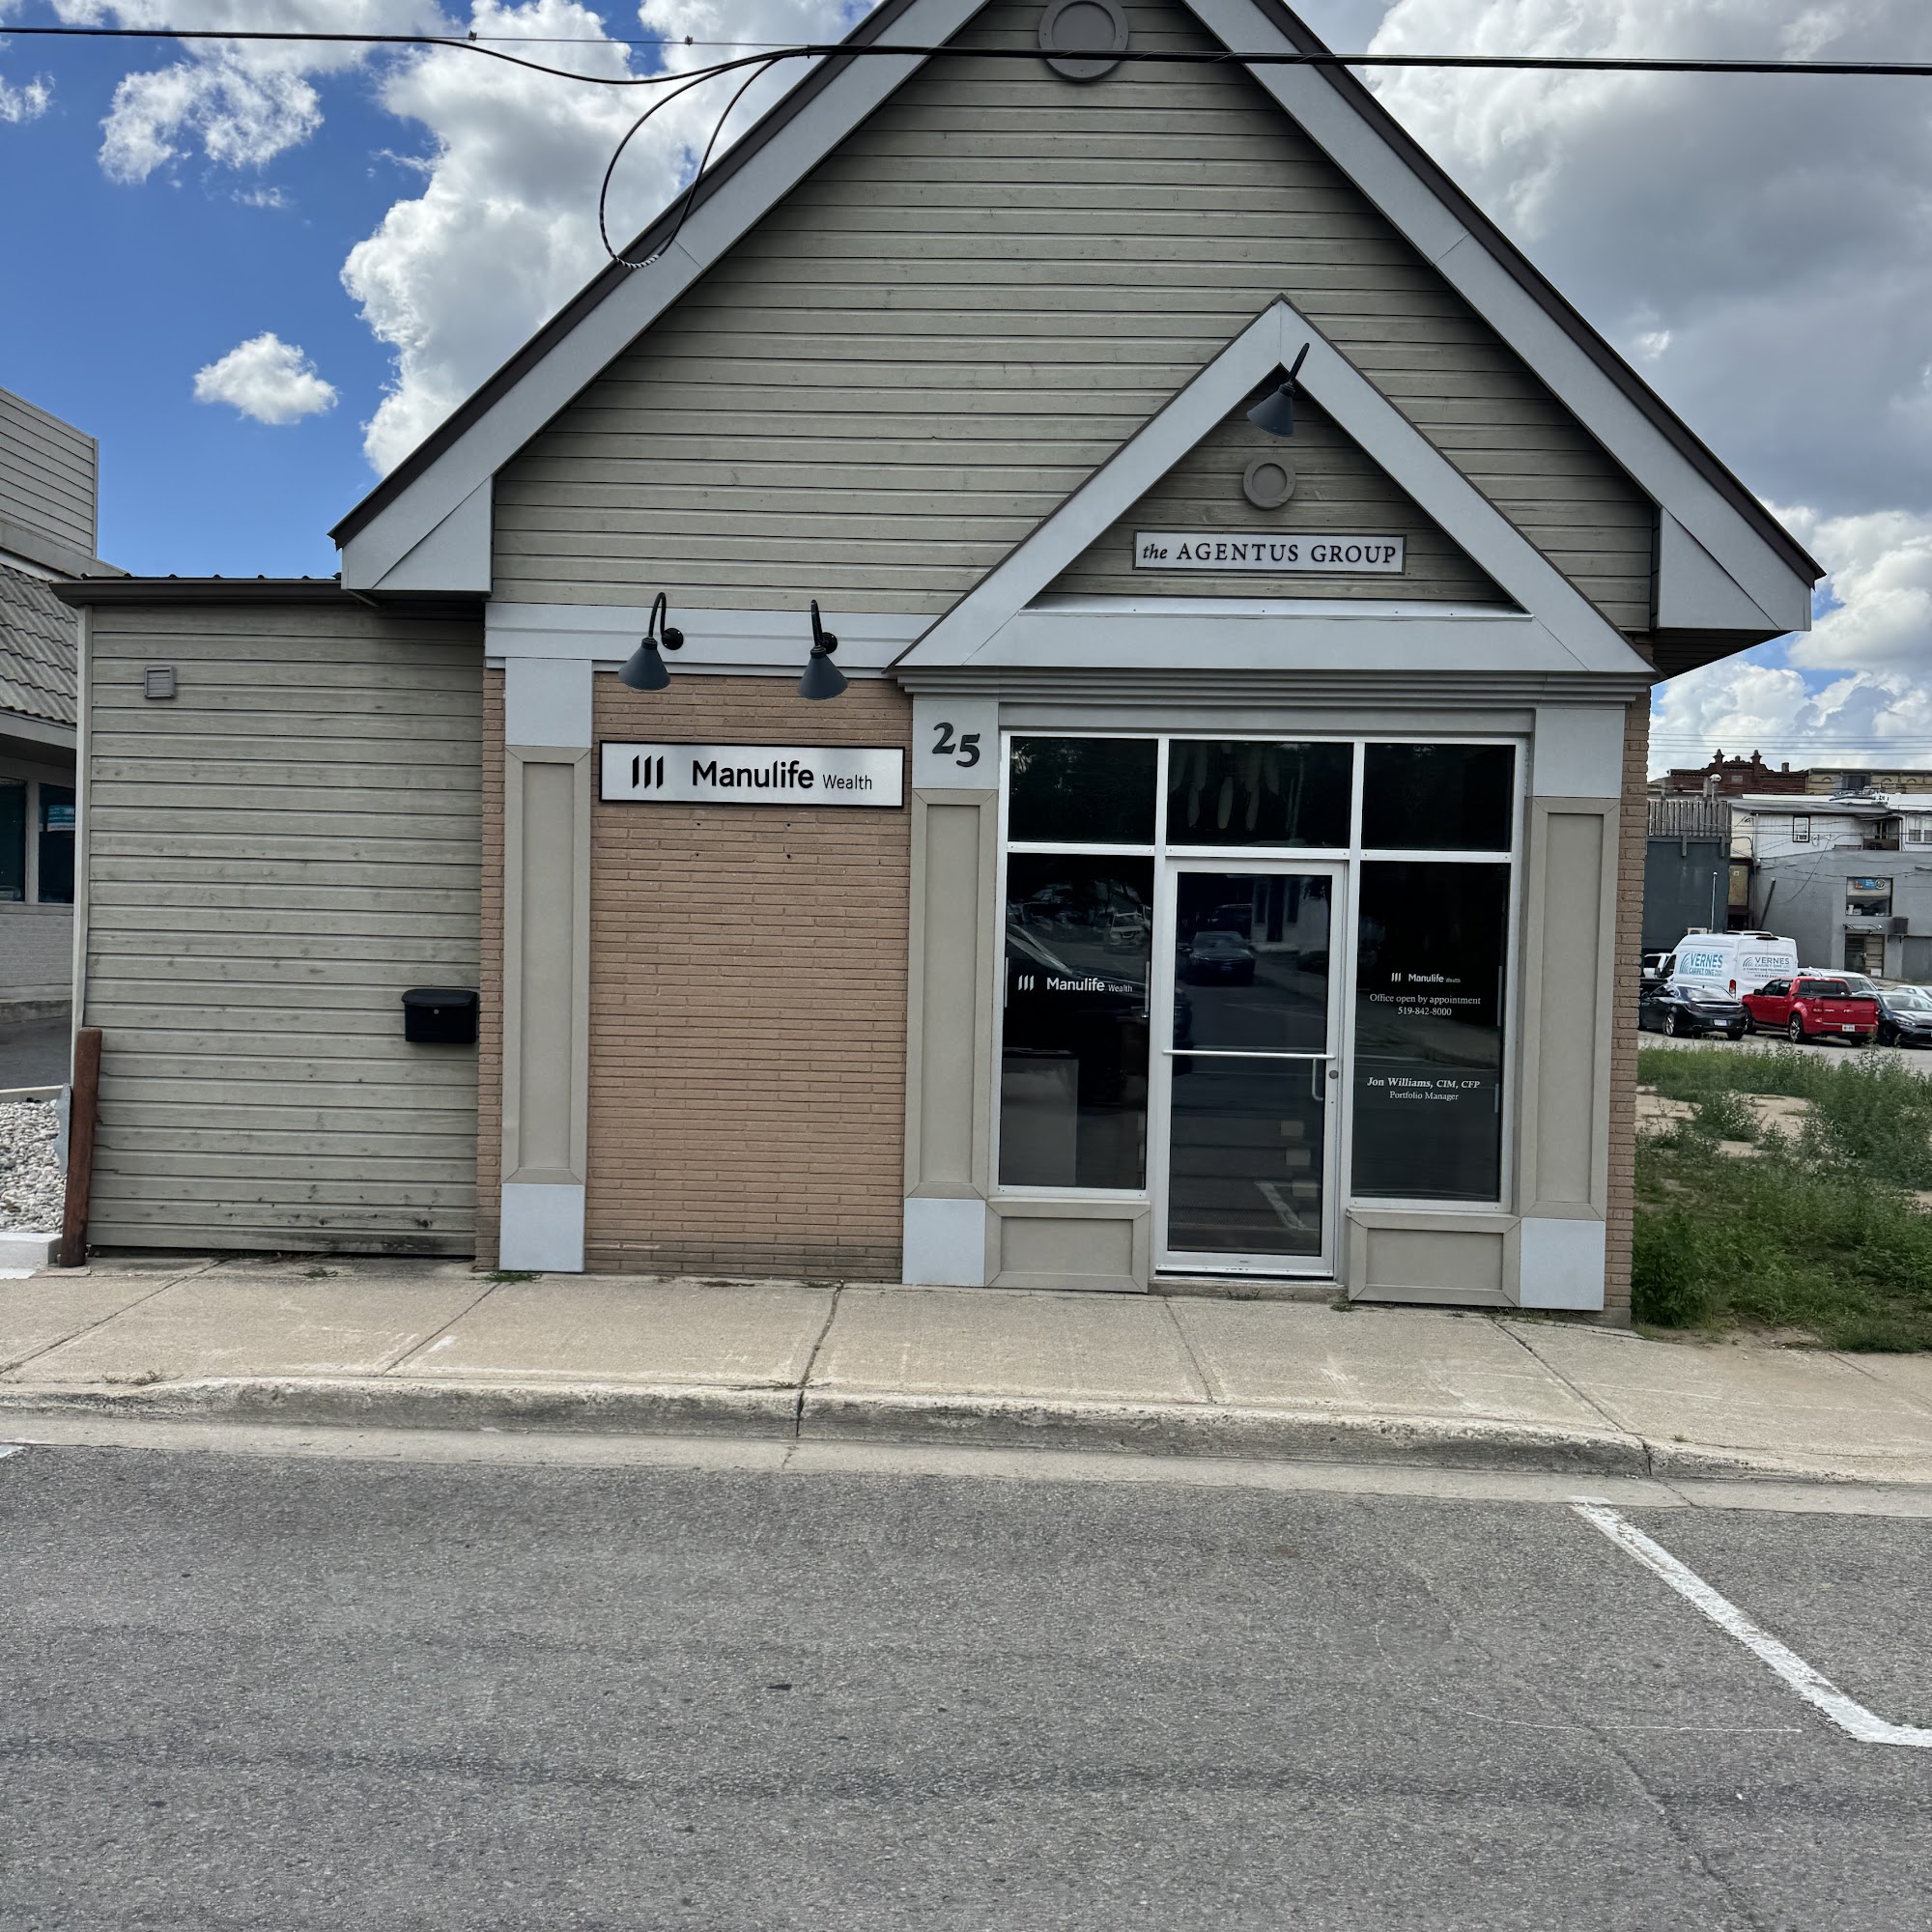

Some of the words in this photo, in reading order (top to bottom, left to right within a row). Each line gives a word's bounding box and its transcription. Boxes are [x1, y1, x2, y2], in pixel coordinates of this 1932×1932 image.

[1143, 544, 1168, 559] the
[1176, 542, 1299, 562] AGENTUS
[1310, 545, 1396, 563] GROUP
[932, 722, 980, 767] 25
[692, 759, 814, 789] Manulife
[823, 774, 872, 790] Wealth
[1690, 952, 1723, 968] VERNES
[1046, 977, 1105, 991] Manulife
[1408, 974, 1444, 982] Manulife
[1370, 993, 1394, 1003] Office
[1418, 995, 1428, 1005] by
[1430, 996, 1481, 1006] appointment
[1398, 1007, 1452, 1016] 519-842-8000
[1367, 1077, 1384, 1086] Jon
[1388, 1078, 1434, 1089] Williams,
[1436, 1080, 1459, 1089] CIM,
[1461, 1080, 1480, 1089] CFP
[1389, 1091, 1423, 1099] Portfolio
[1425, 1092, 1459, 1101] Manager
